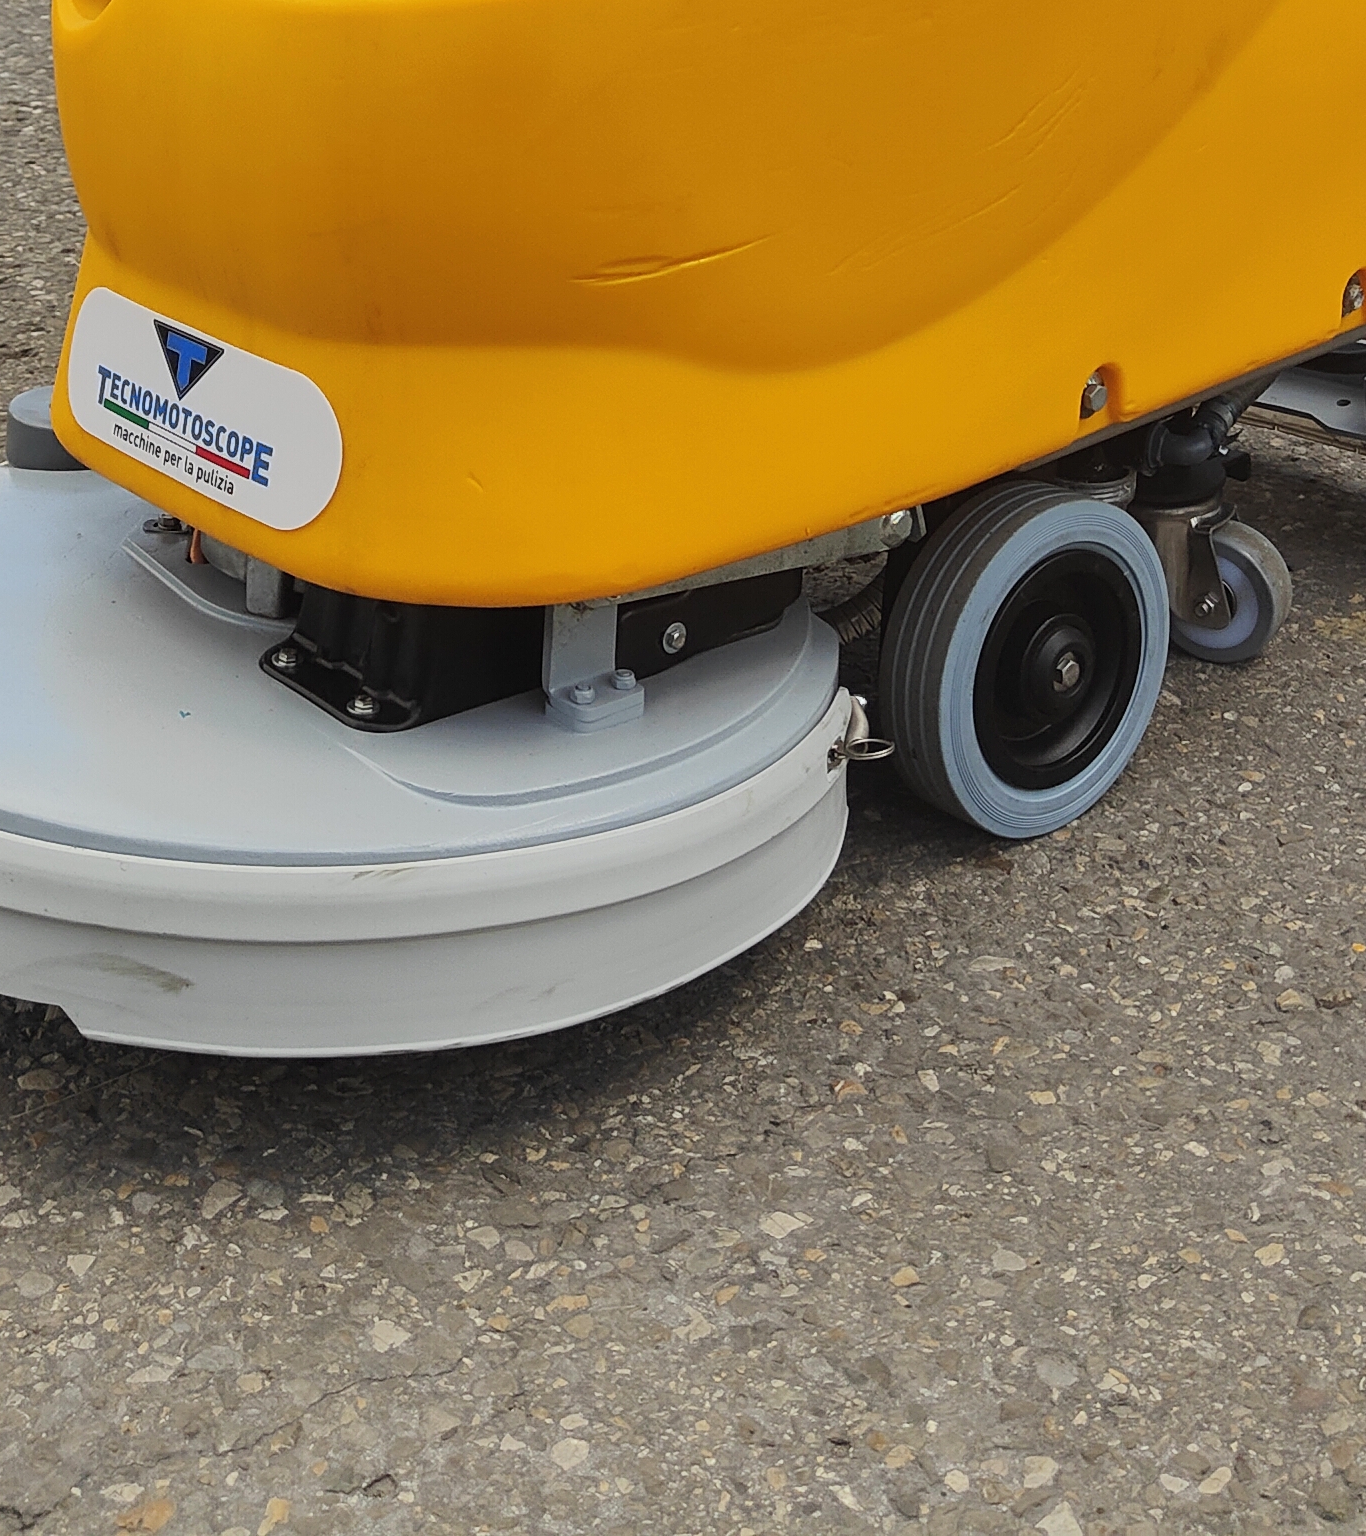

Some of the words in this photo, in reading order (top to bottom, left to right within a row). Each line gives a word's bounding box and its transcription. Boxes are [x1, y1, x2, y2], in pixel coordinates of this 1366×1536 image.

[98, 365, 273, 487] TECNOMOTOSCOPE
[112, 422, 161, 458] macchine
[163, 451, 182, 468] per
[184, 455, 194, 475] la
[196, 465, 235, 495] pulizia
